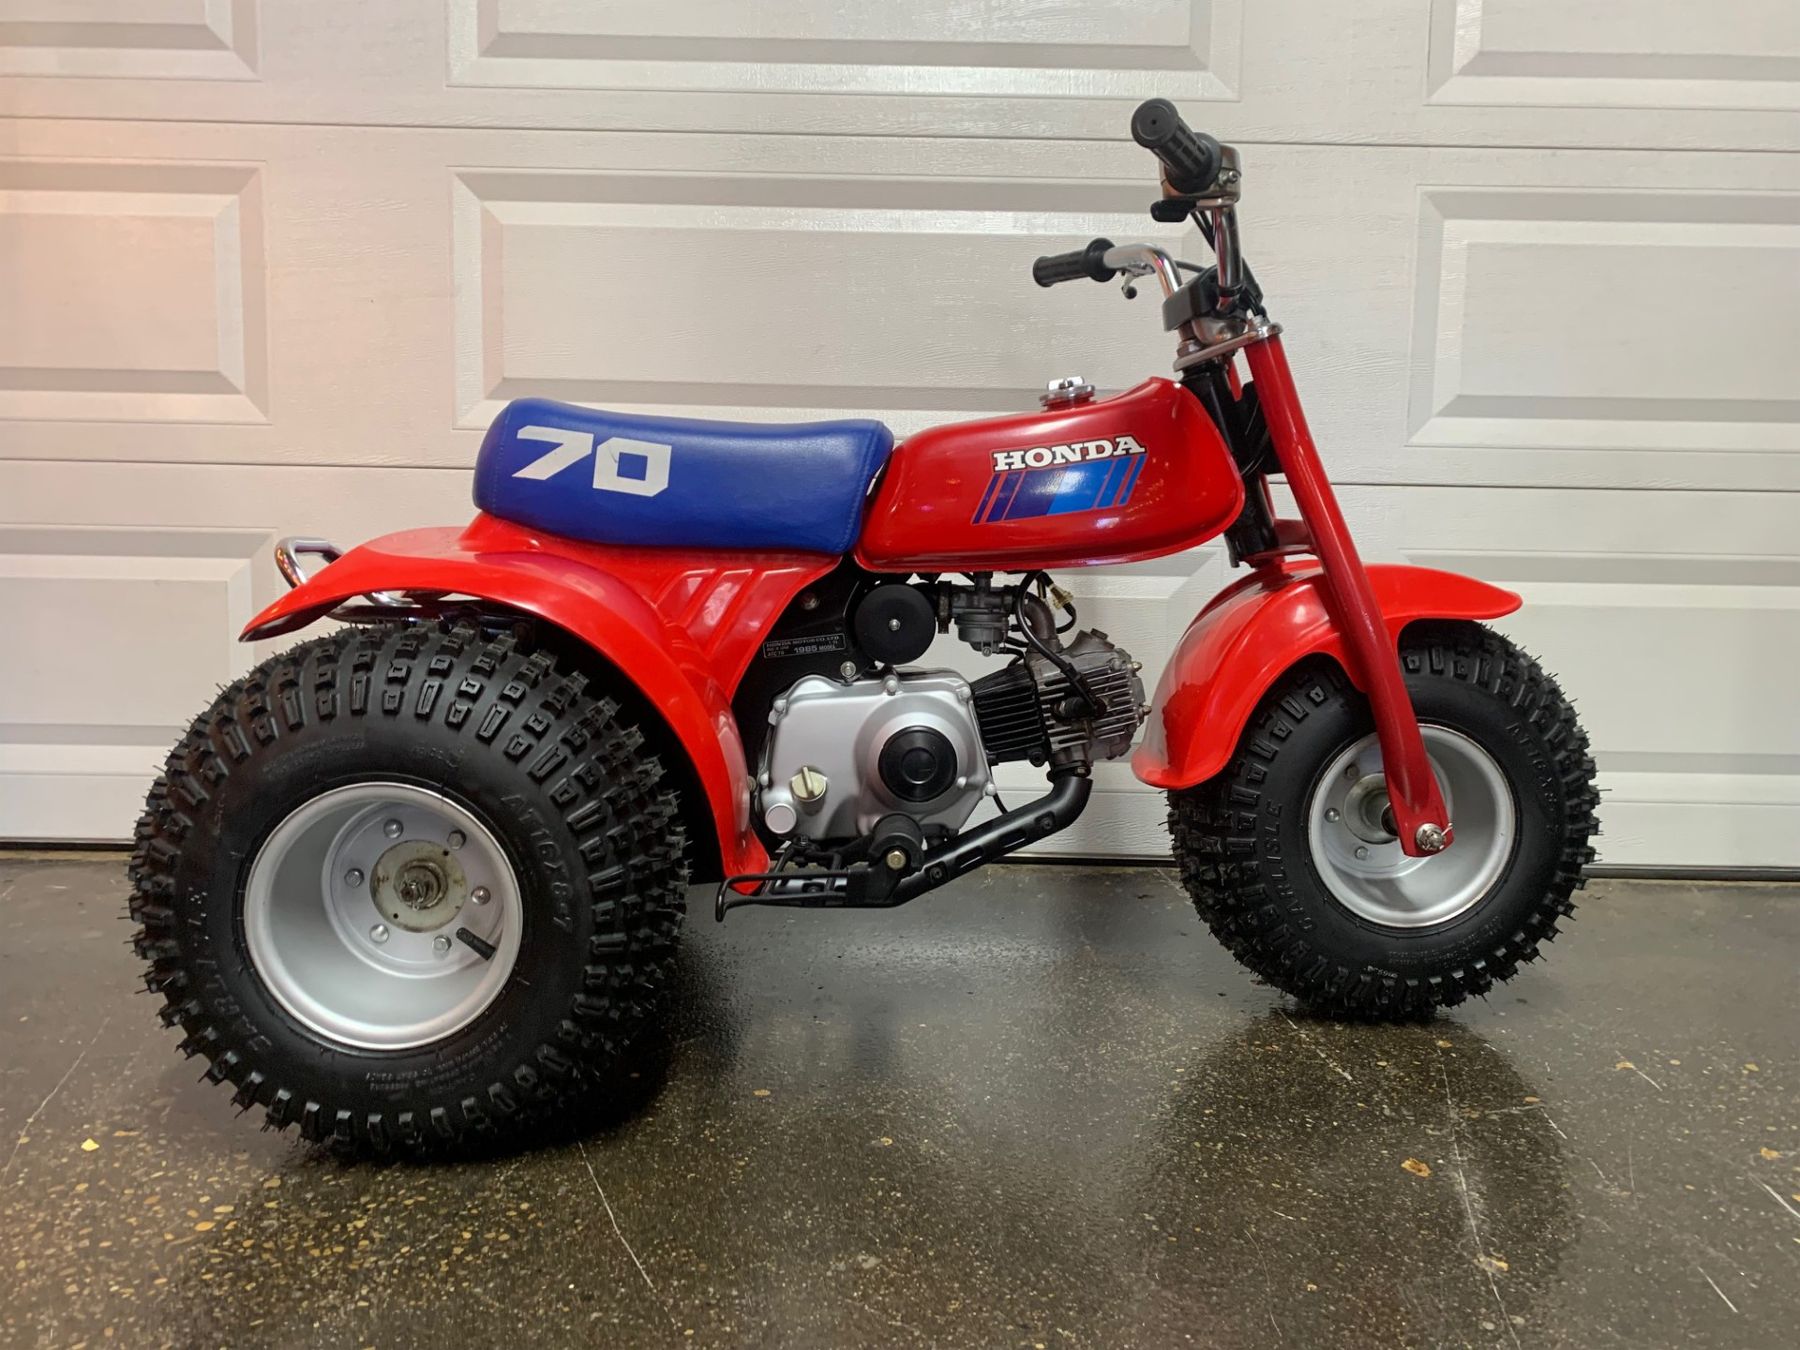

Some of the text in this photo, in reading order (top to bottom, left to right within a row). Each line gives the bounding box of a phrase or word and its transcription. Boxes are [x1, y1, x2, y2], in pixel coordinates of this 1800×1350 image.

[512, 425, 672, 497] 70
[993, 436, 1145, 471] HONDA
[1264, 799, 1316, 931] CARLISLE
